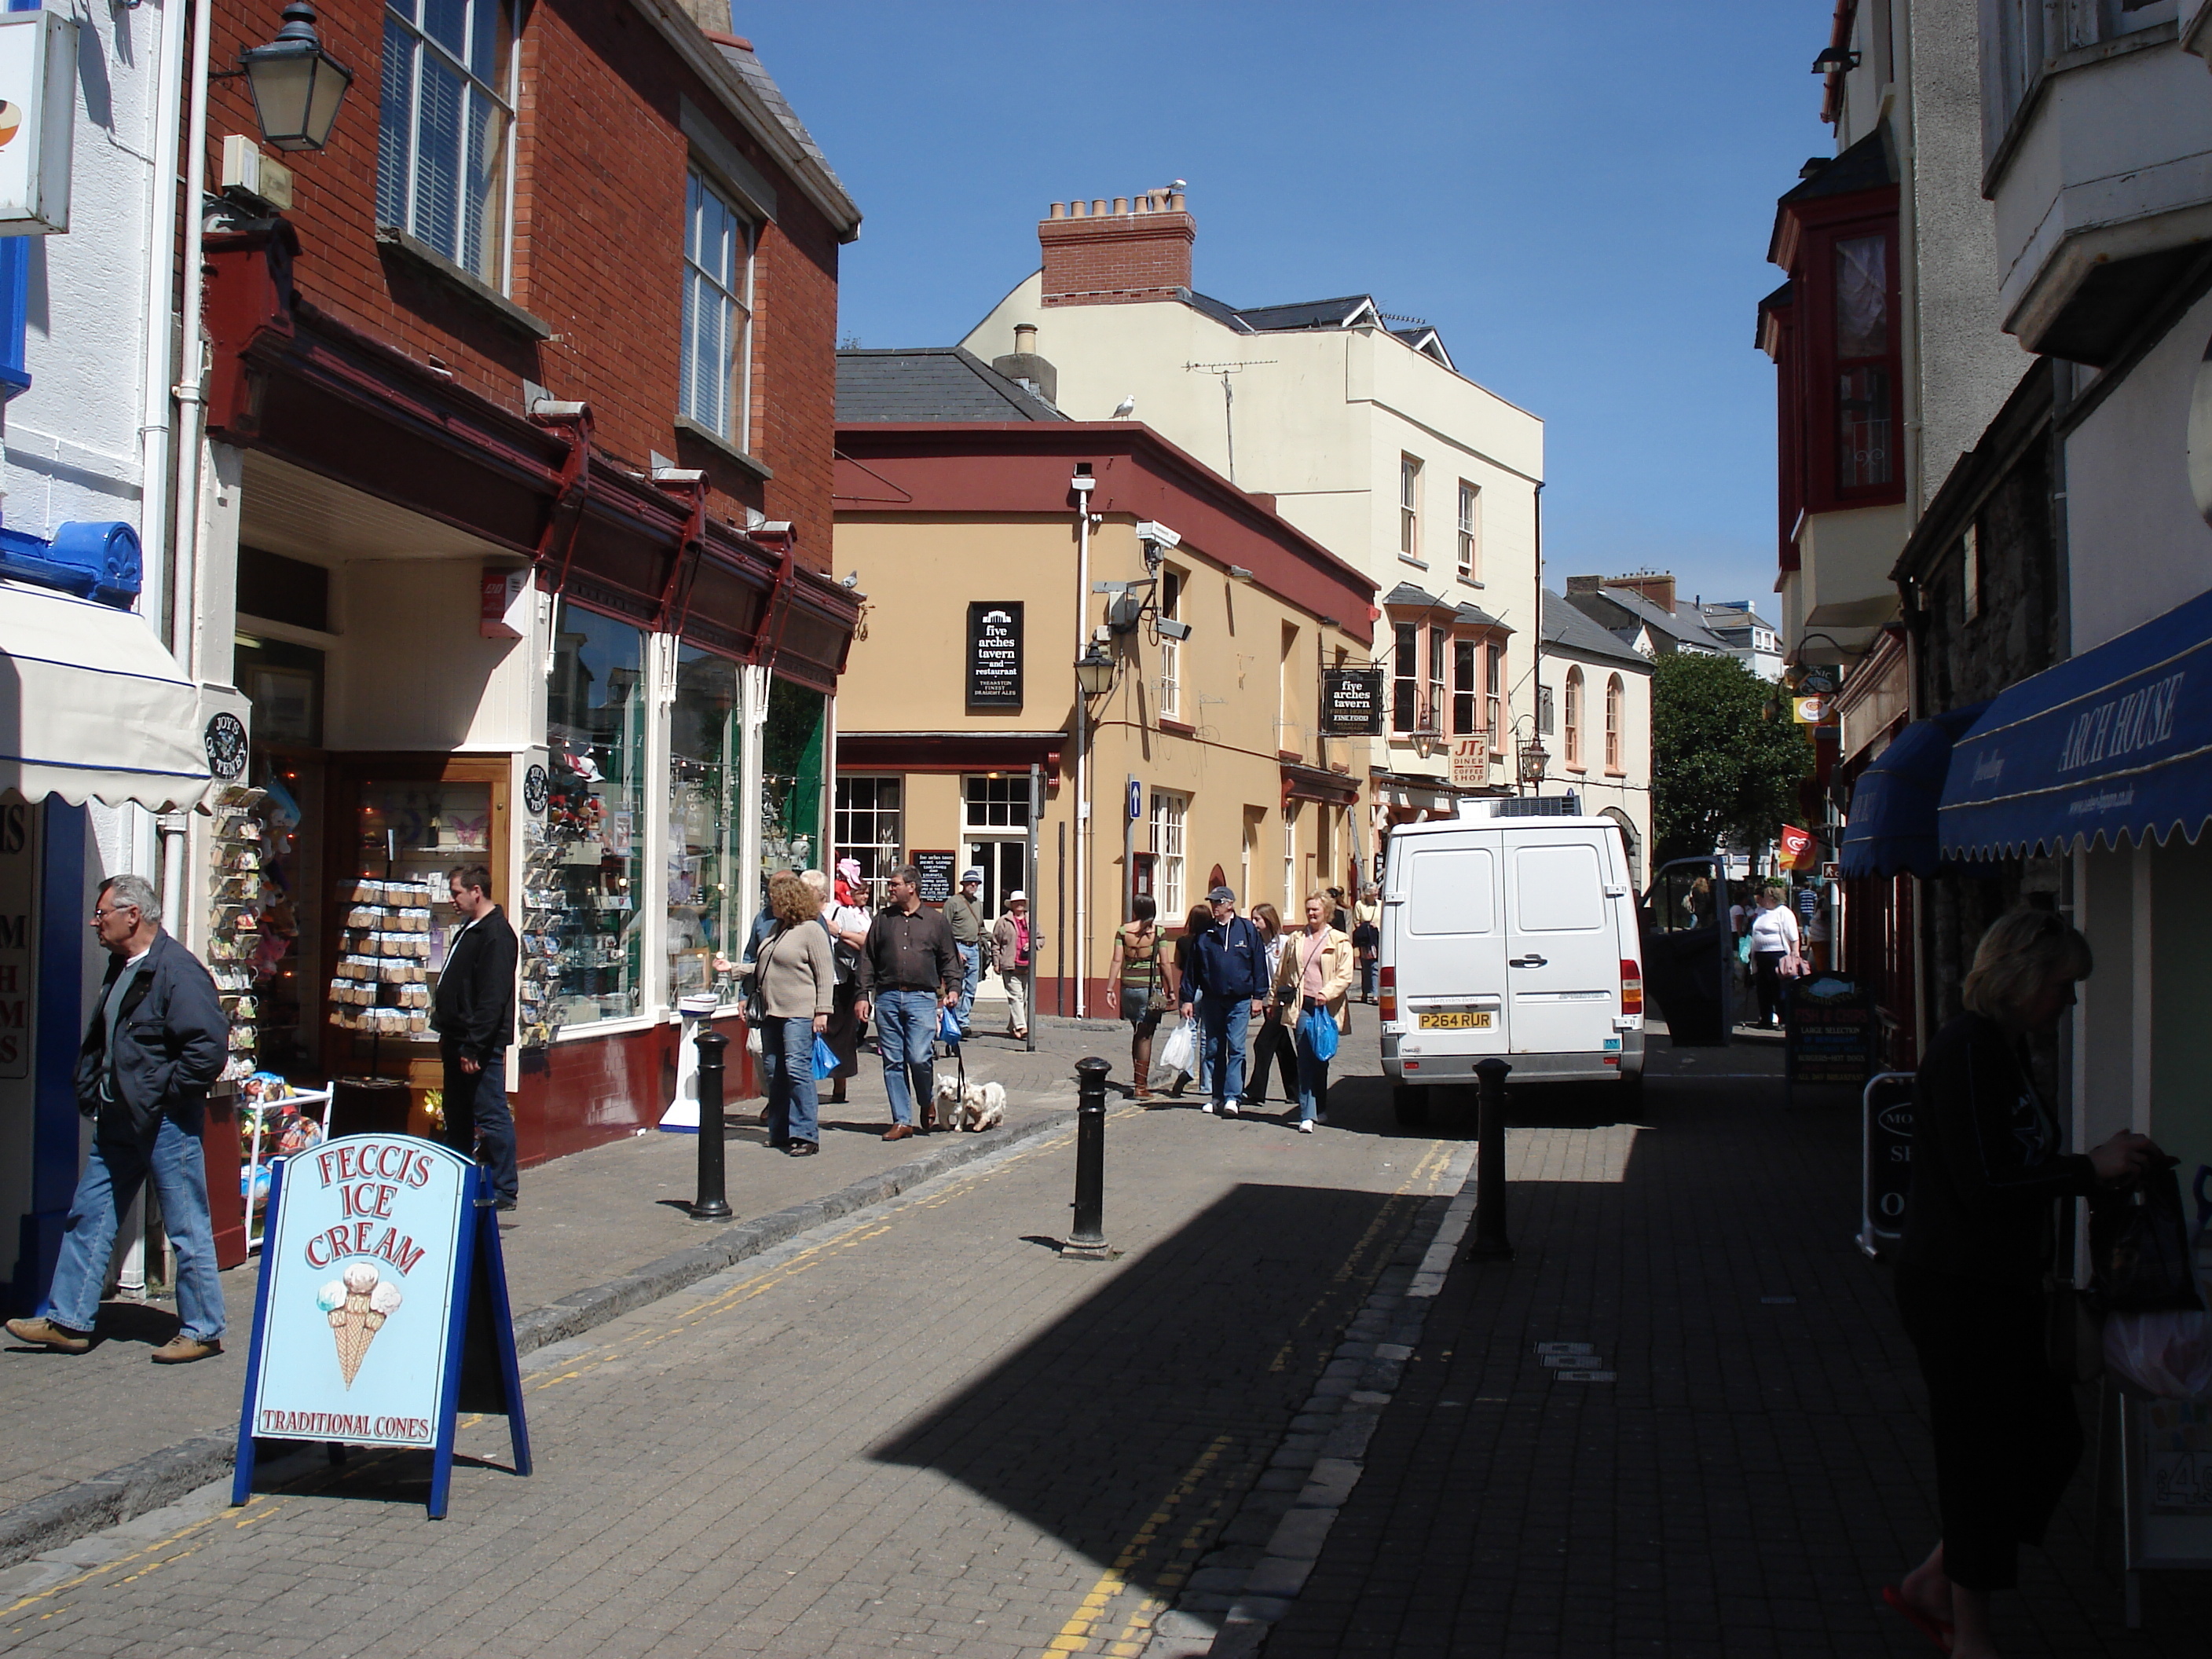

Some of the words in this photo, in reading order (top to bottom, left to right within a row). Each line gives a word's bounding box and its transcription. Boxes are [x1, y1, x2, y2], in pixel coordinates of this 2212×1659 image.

[986, 625, 1007, 635] five
[979, 636, 1015, 647] arches
[979, 649, 1015, 658] tavern
[1342, 680, 1363, 690] five
[1333, 689, 1371, 699] arches
[215, 716, 240, 735] JOY'S
[2057, 701, 2117, 772] ARCH
[2108, 671, 2185, 757] HOUSE
[206, 736, 217, 758] OF
[215, 742, 247, 775] TENBY
[1455, 740, 1485, 756] JT's
[1422, 1015, 1458, 1027] P264
[1462, 1014, 1489, 1027] RUR
[1795, 1009, 1819, 1022] FISH
[1822, 1009, 1833, 1022] &
[1835, 1009, 1869, 1022] CHIPS
[316, 1144, 434, 1189] FECCI'S
[339, 1182, 397, 1220] ICE
[305, 1222, 426, 1277] CREAM
[263, 1410, 371, 1436] TRADITIONAL
[374, 1416, 429, 1438] CONES
